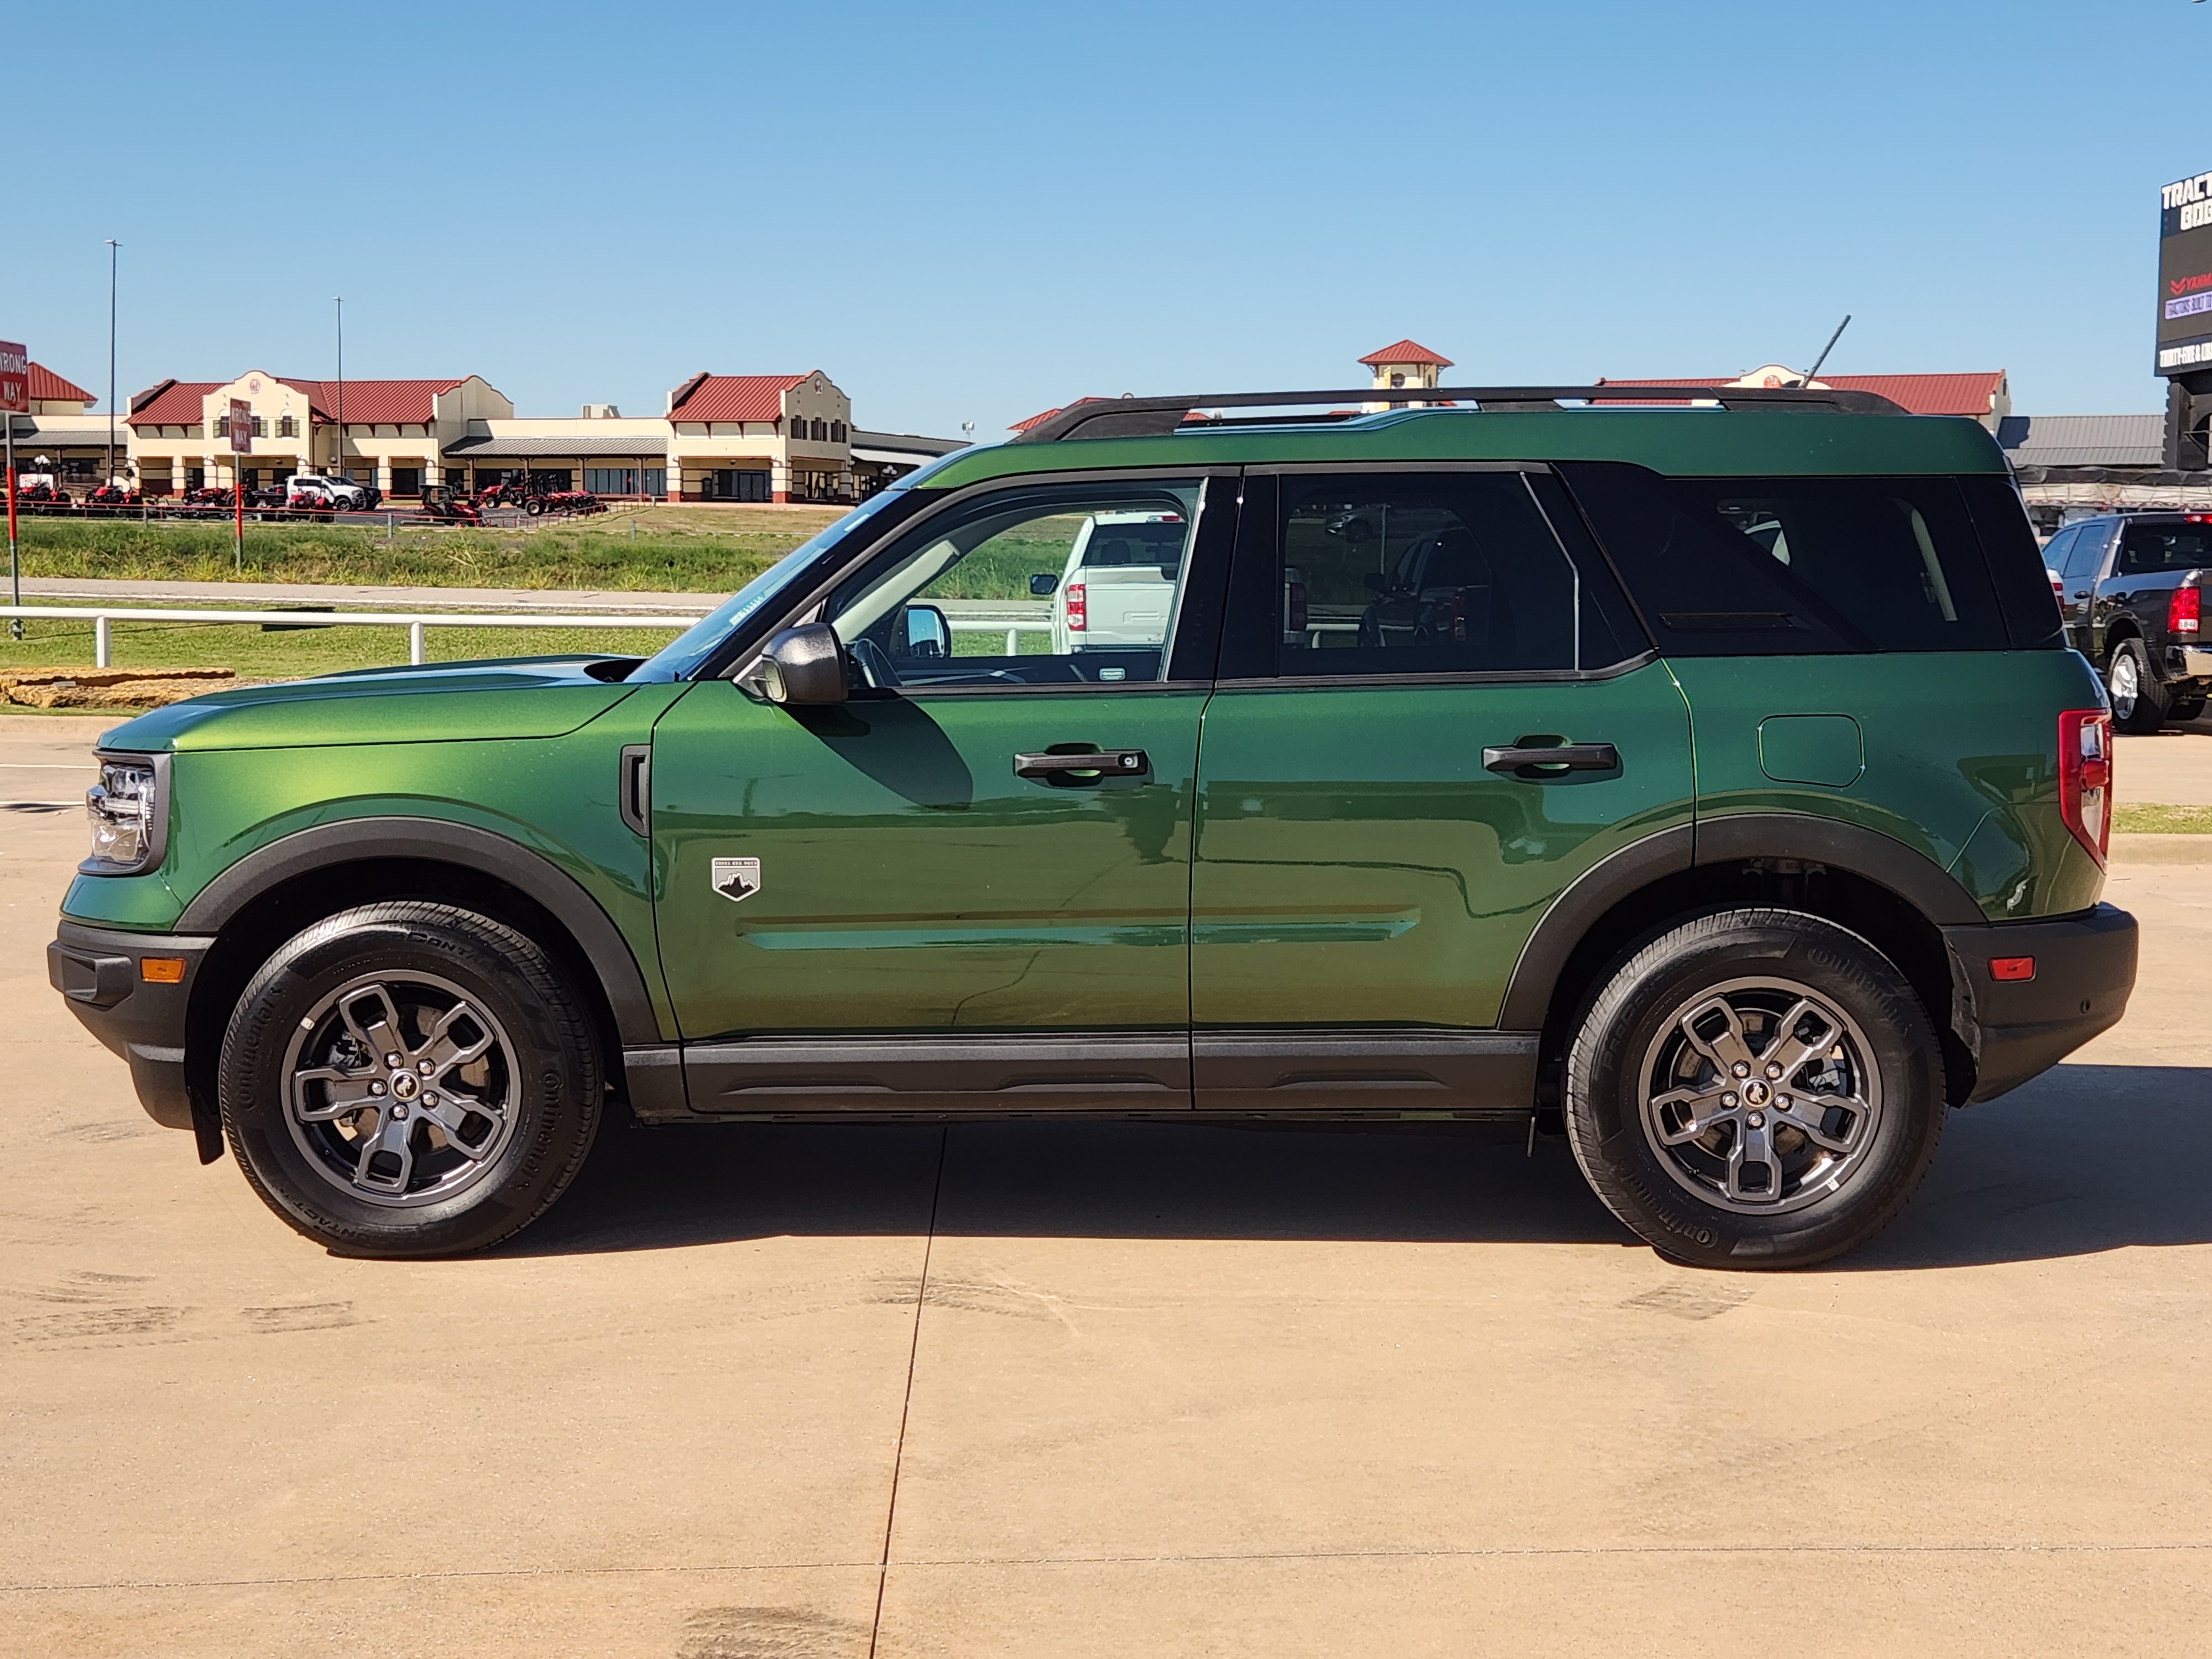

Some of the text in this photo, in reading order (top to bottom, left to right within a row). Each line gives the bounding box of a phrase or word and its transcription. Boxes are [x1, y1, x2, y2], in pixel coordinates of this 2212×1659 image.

[3, 380, 22, 403] WAY
[231, 407, 252, 425] WRONG
[234, 429, 247, 445] WAY
